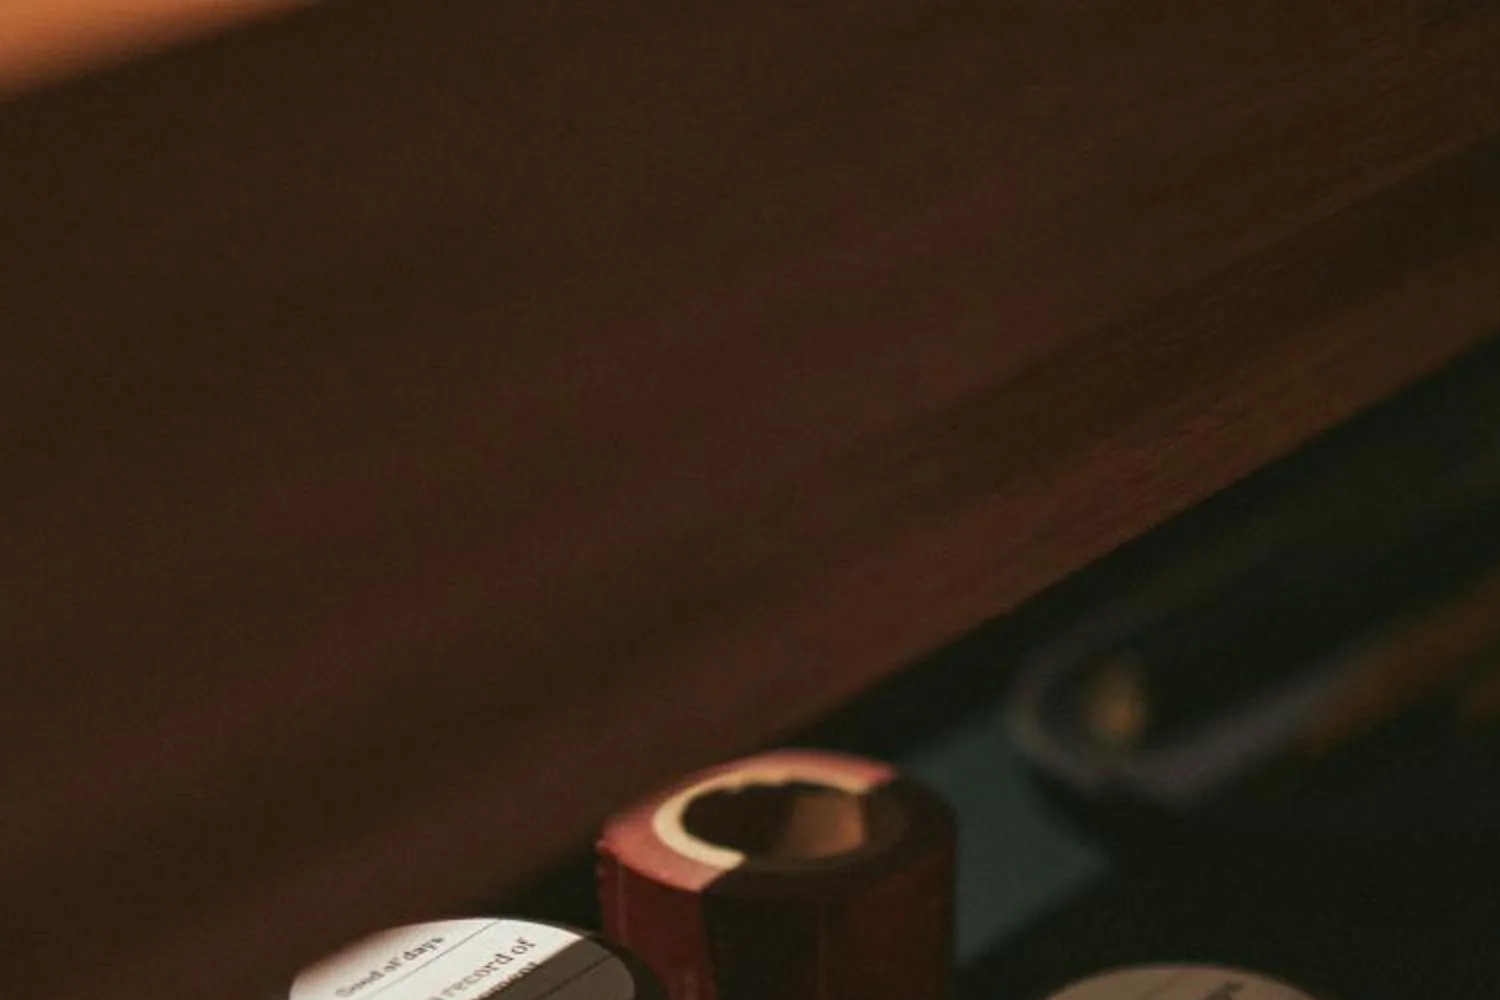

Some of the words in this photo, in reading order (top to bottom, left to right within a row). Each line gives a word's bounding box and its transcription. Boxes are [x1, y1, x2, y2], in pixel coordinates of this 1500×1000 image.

[335, 969, 386, 998] Good
[401, 935, 446, 963] days
[442, 951, 515, 999] record
[510, 935, 537, 957] of
